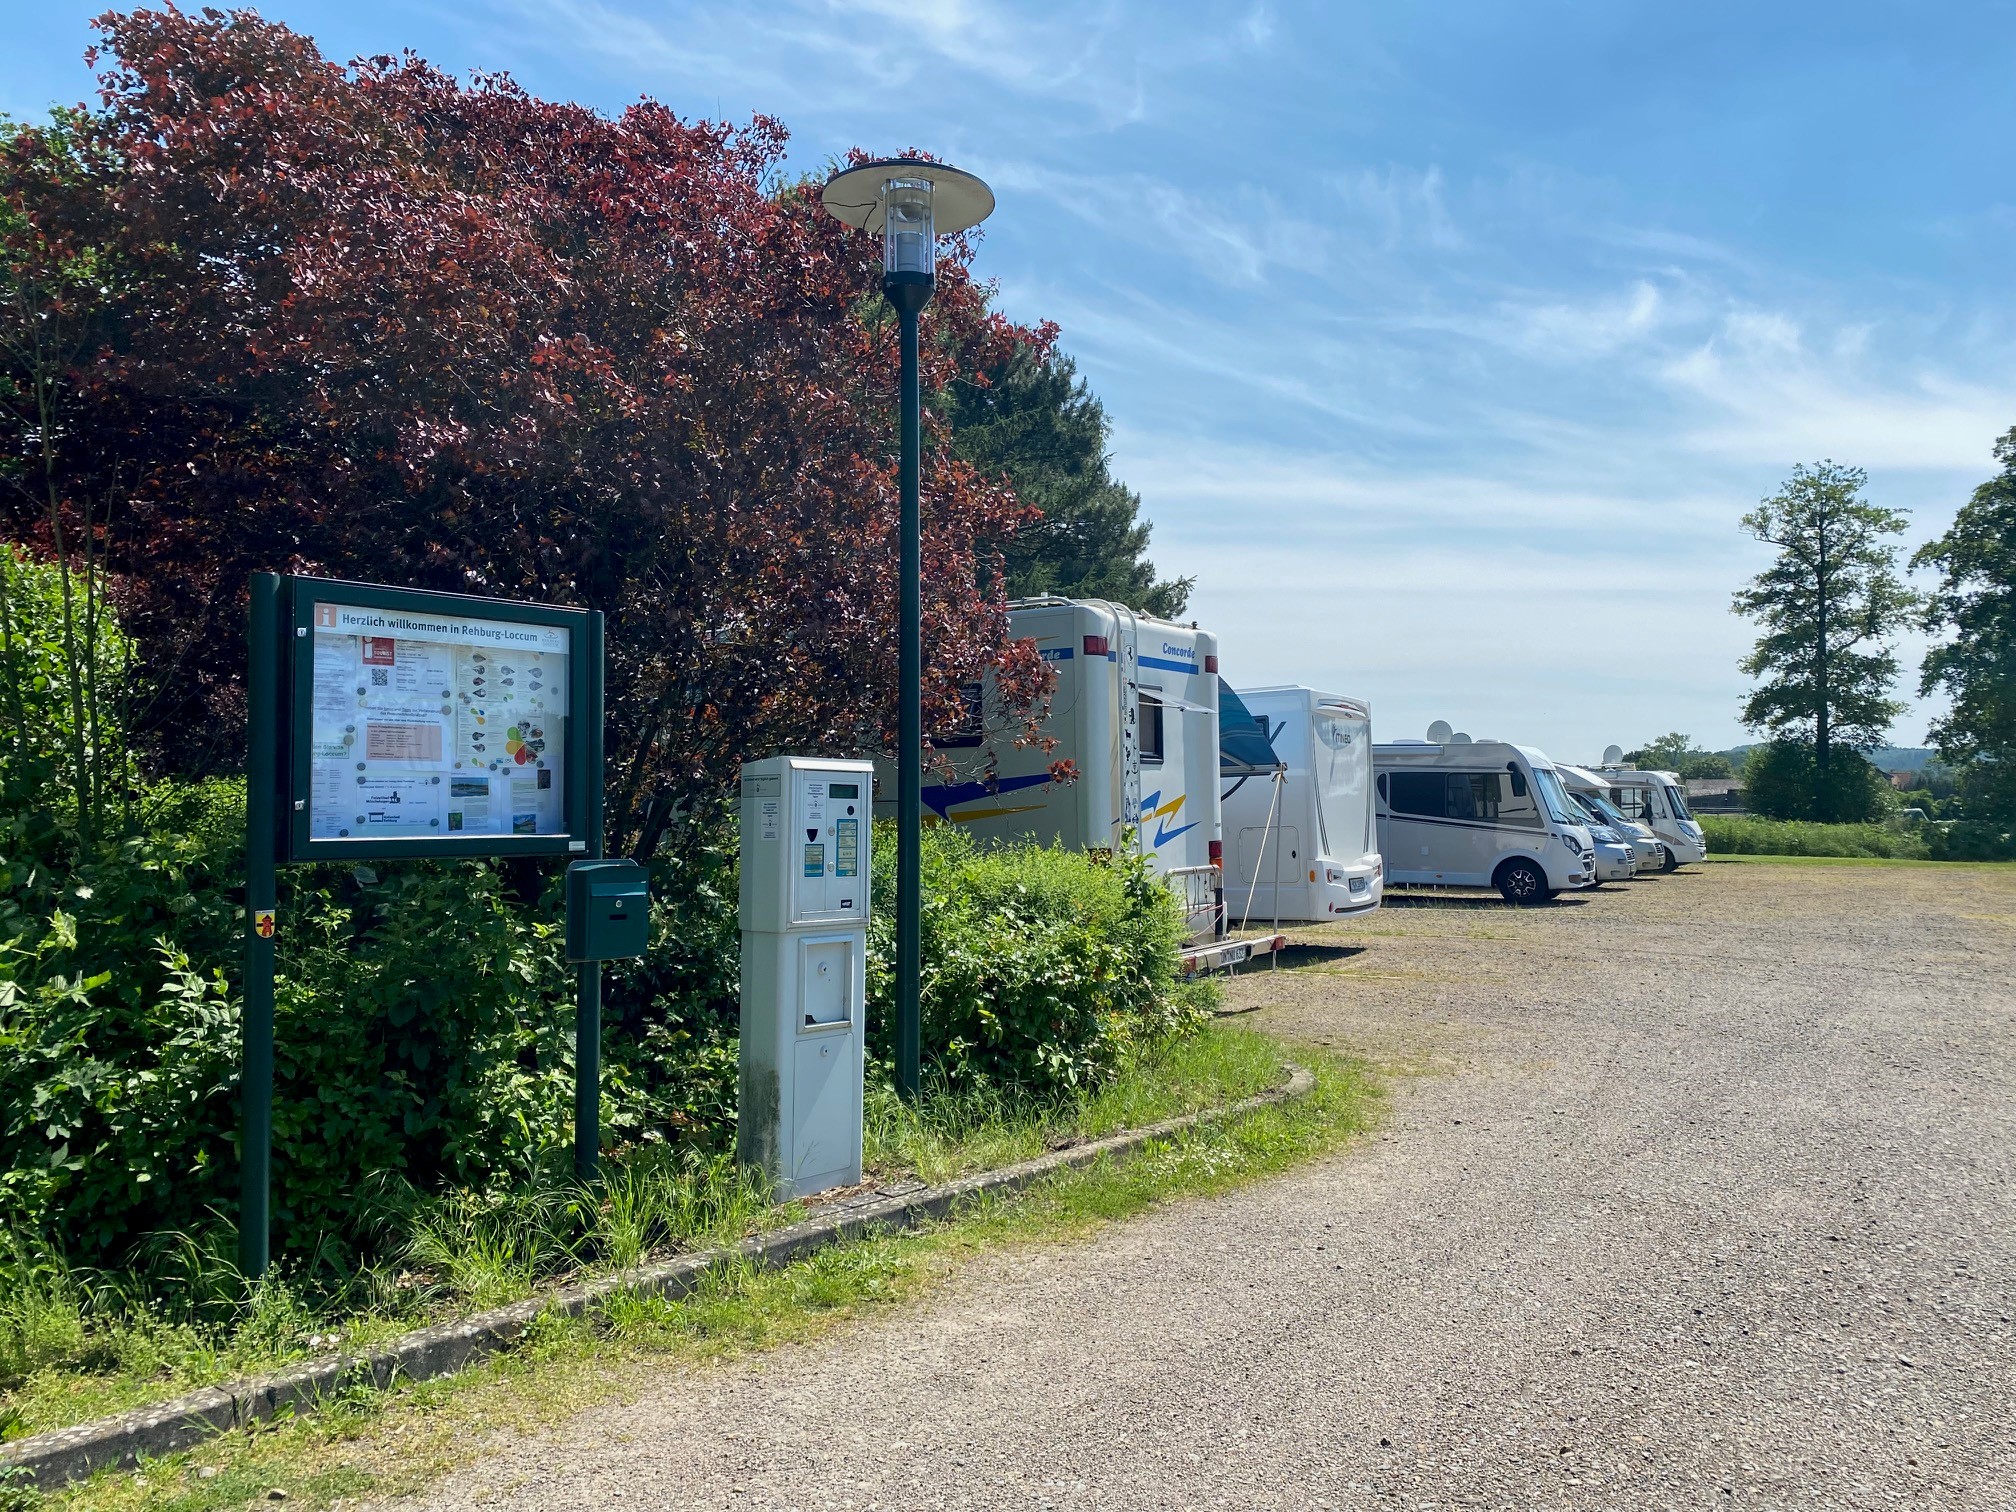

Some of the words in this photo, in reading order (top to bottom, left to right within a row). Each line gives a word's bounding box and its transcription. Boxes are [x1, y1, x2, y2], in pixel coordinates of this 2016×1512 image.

[342, 613, 385, 627] Herzlich
[387, 619, 448, 633] willkommen
[450, 624, 459, 634] in
[462, 625, 538, 642] Rehburg-Loccum
[1162, 642, 1196, 659] Concorde
